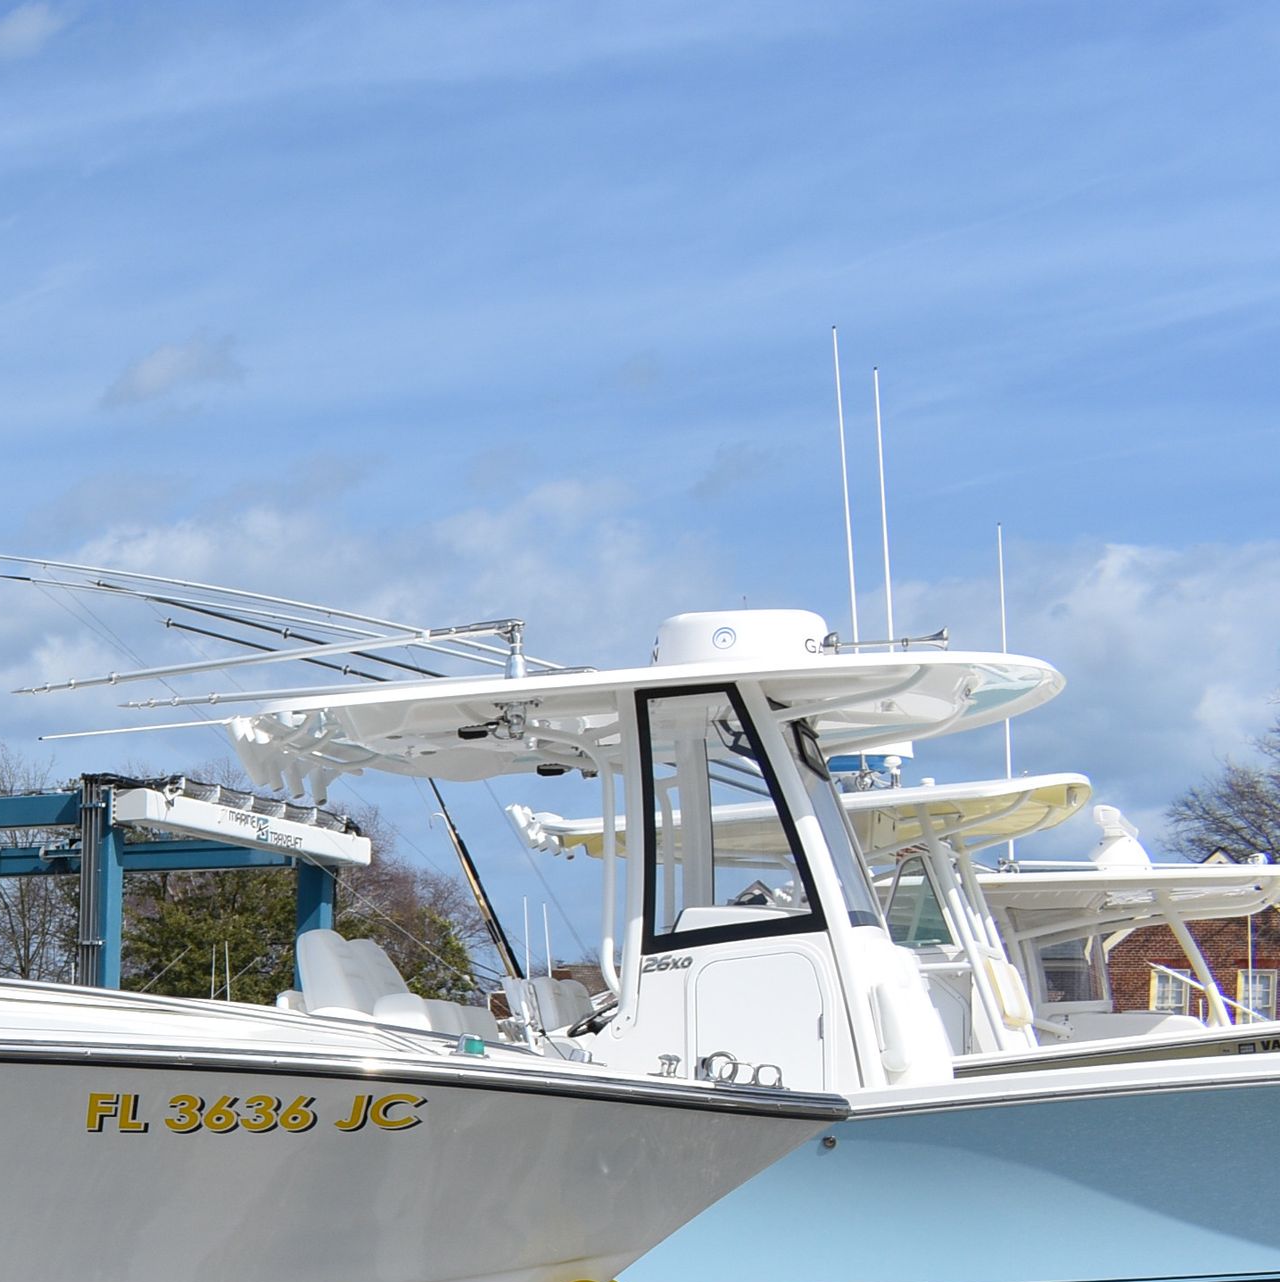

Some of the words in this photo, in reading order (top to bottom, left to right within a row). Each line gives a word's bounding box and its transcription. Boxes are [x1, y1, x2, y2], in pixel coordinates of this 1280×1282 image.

[86, 1093, 150, 1134] FL
[164, 1093, 318, 1135] 3636
[333, 1093, 428, 1133] JC
